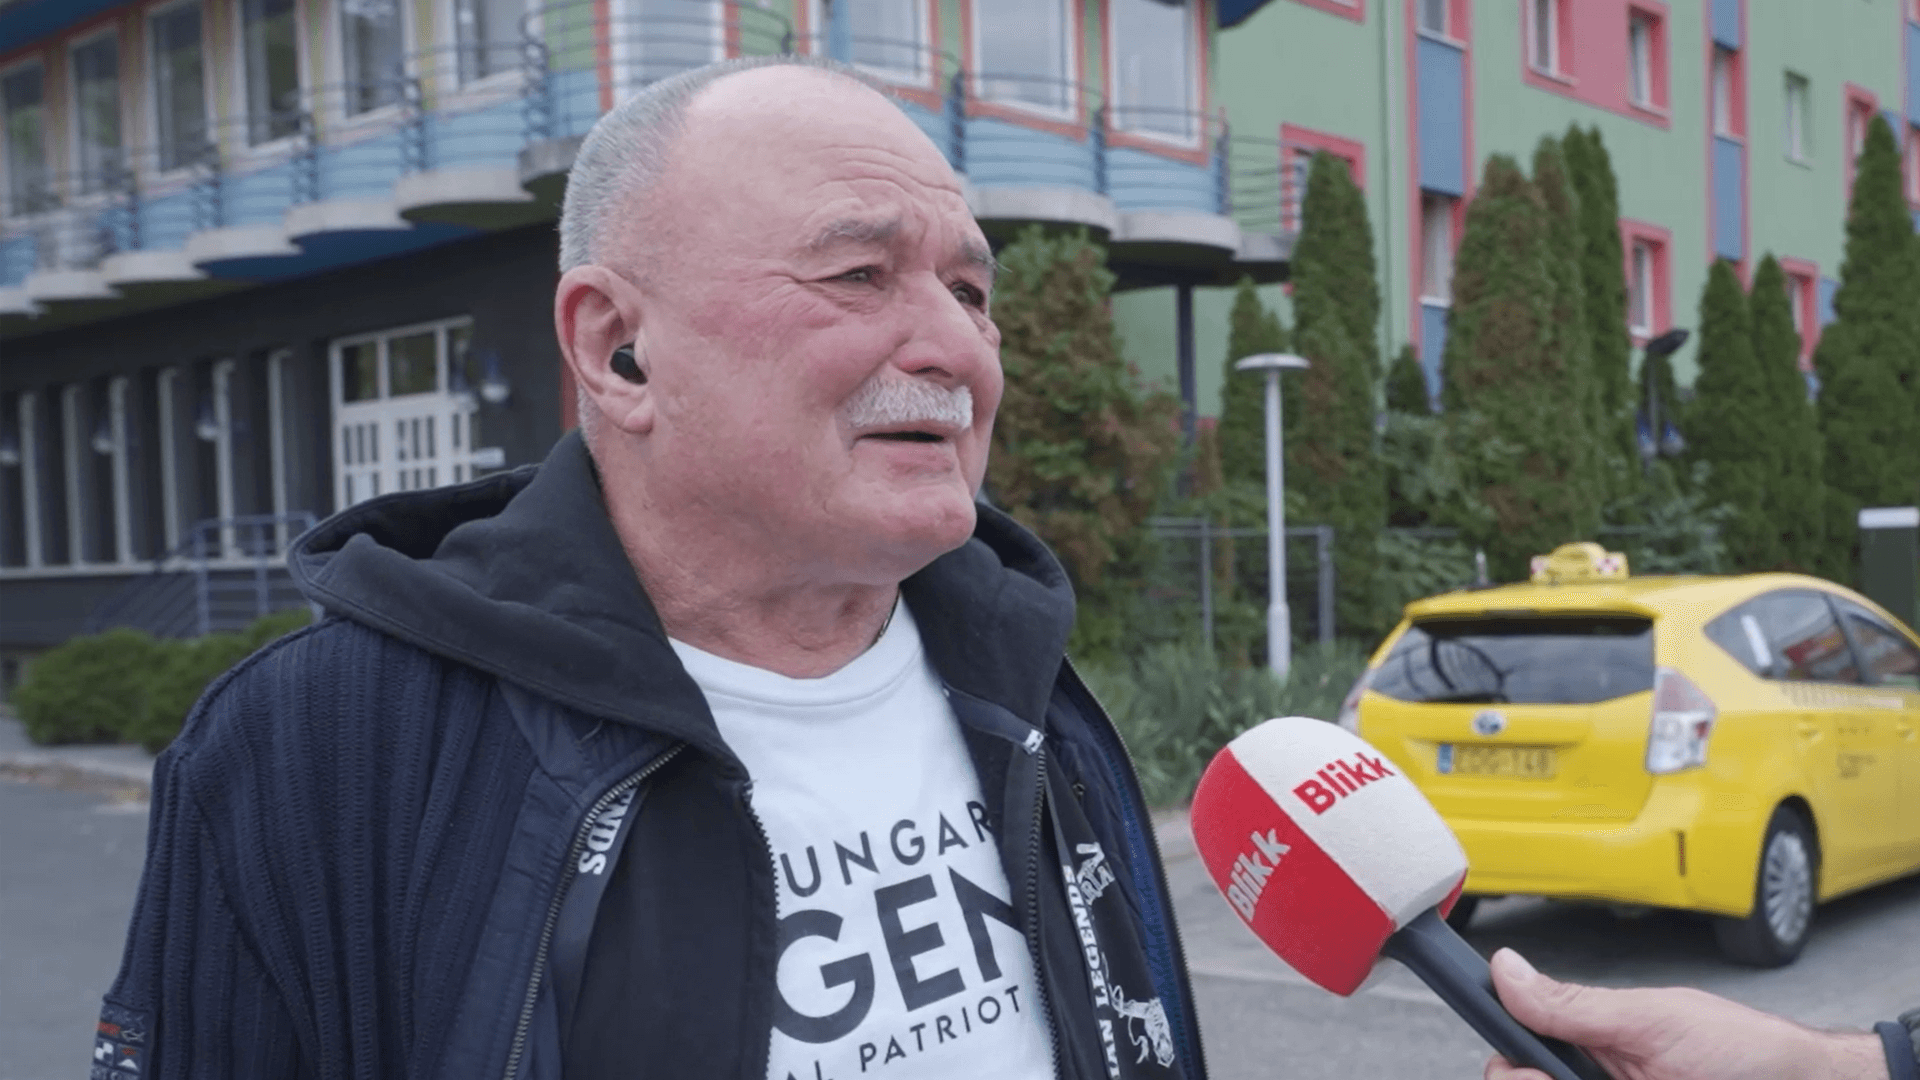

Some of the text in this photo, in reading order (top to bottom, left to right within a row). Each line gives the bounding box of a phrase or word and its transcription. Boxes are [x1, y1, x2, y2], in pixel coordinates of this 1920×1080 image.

[1292, 752, 1396, 816] Blikk
[1226, 828, 1292, 922] Blikk
[1062, 864, 1110, 1008] LEGENDS
[859, 984, 1020, 1073] PATRIOT
